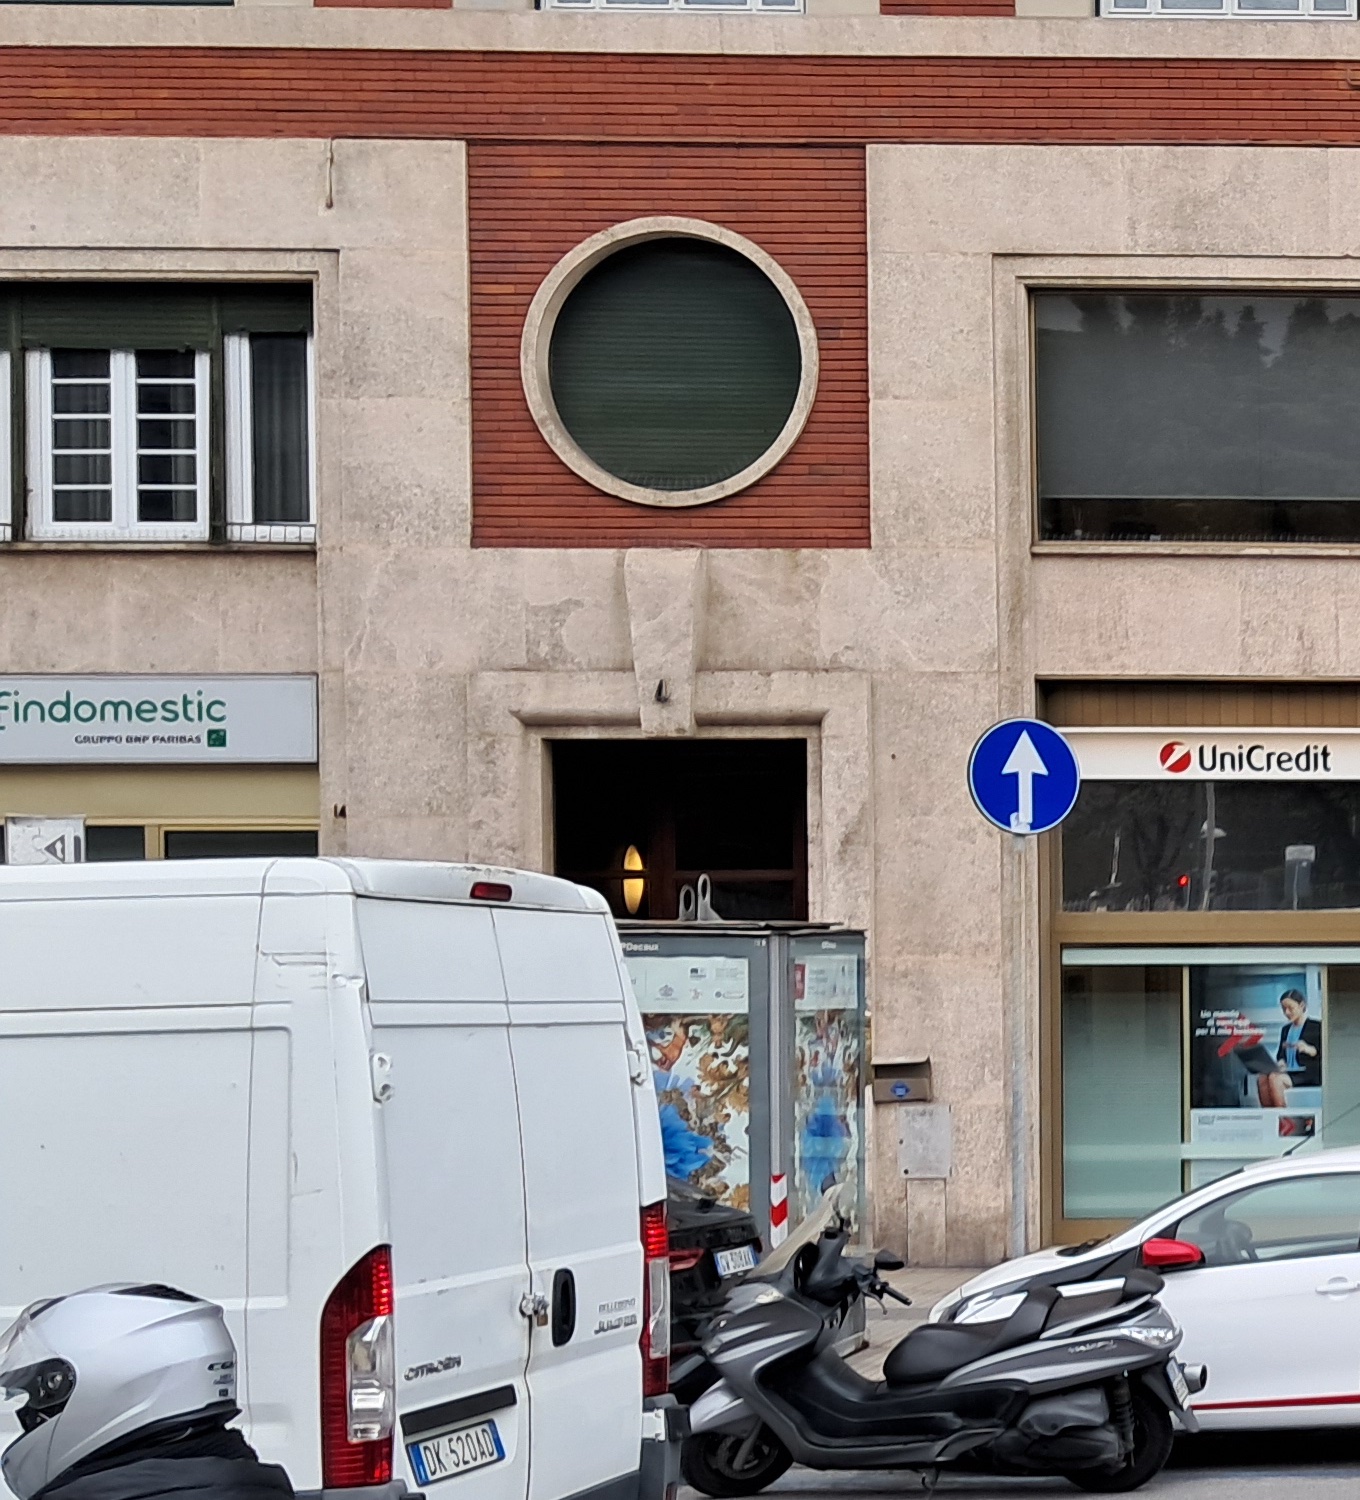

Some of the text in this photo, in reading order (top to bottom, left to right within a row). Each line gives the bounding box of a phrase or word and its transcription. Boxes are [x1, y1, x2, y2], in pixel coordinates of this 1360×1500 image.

[74, 734, 202, 745] GRUPPO BNP PARIBAS
[1198, 744, 1331, 773] UniCredit
[422, 1426, 496, 1477] DK 520AD
